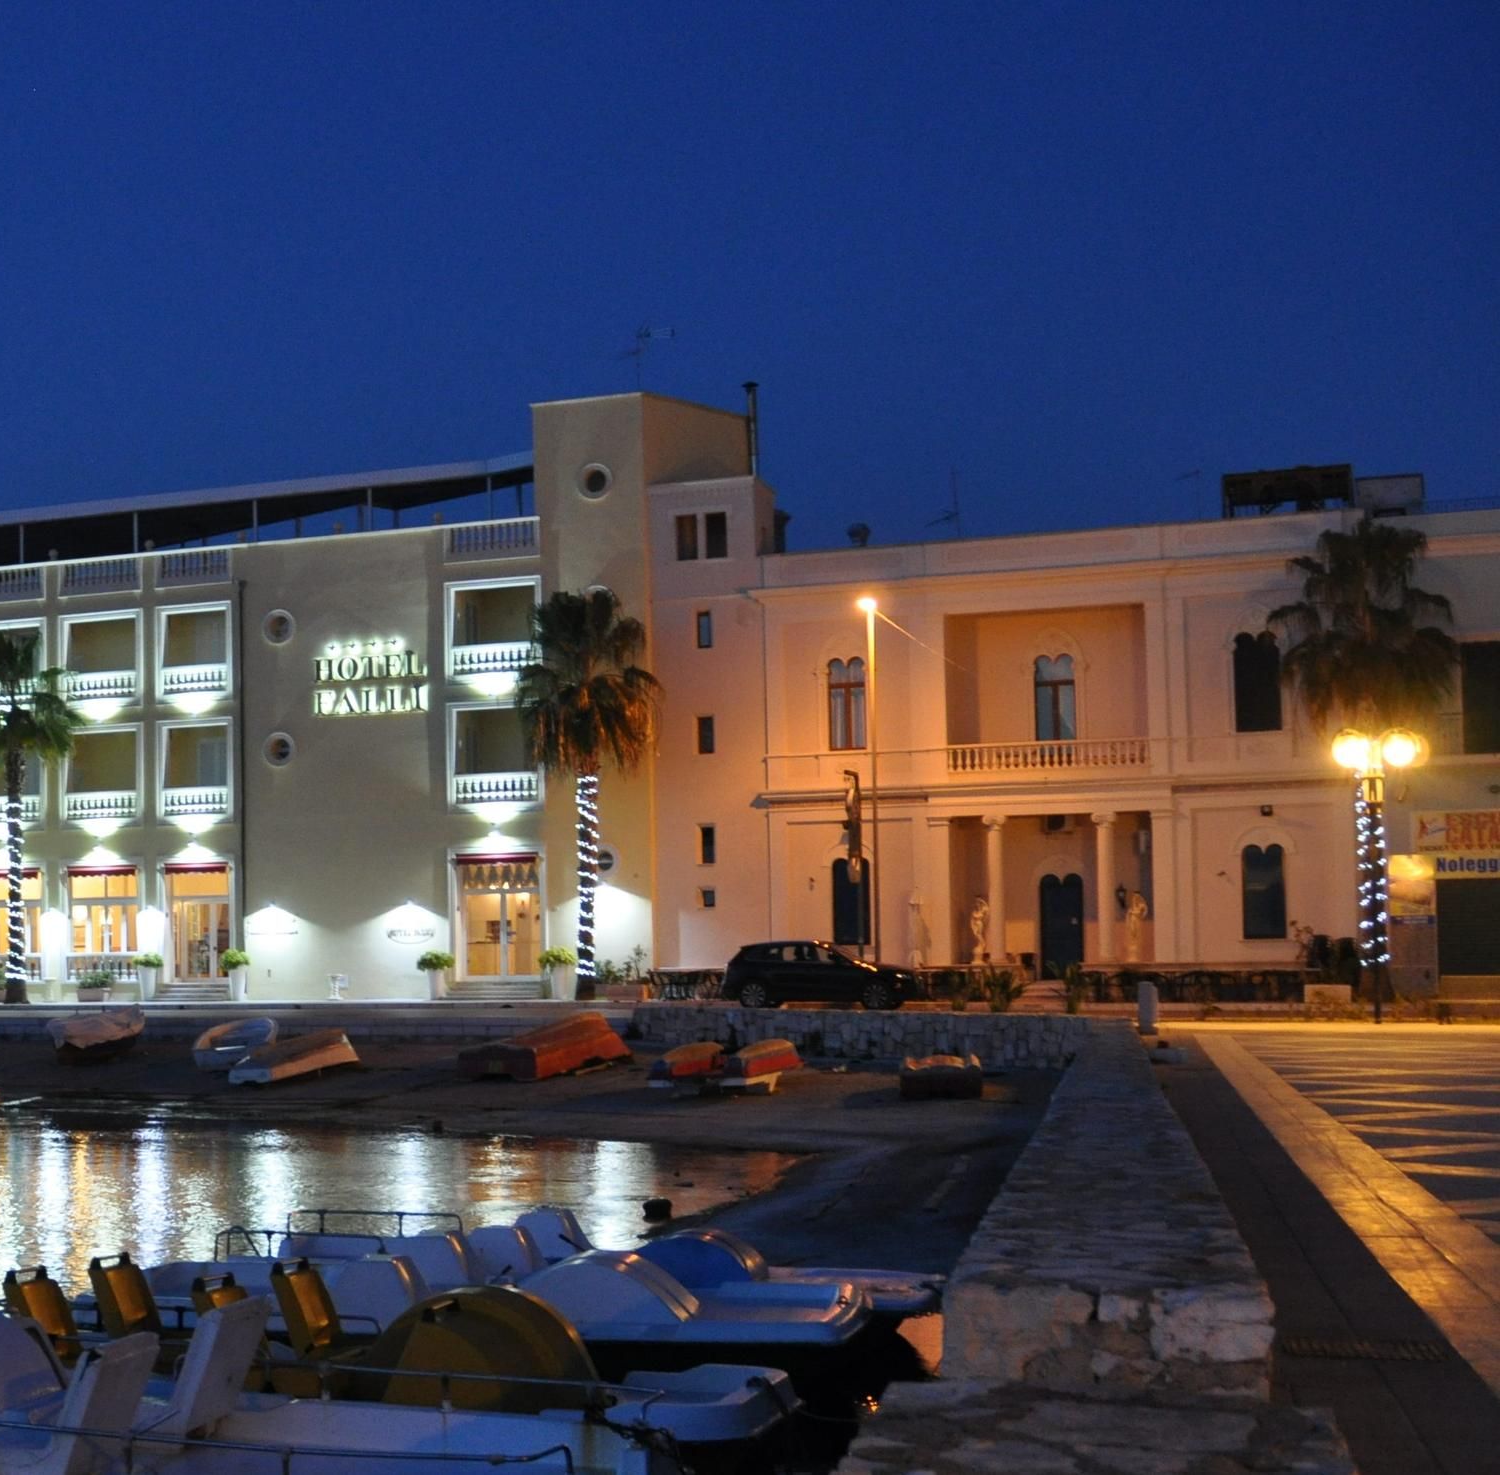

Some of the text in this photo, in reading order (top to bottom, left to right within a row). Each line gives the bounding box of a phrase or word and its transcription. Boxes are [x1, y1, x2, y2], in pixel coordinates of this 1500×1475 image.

[313, 650, 427, 682] HOTEL
[314, 682, 428, 714] FALLI
[1436, 857, 1499, 873] Nolegg
